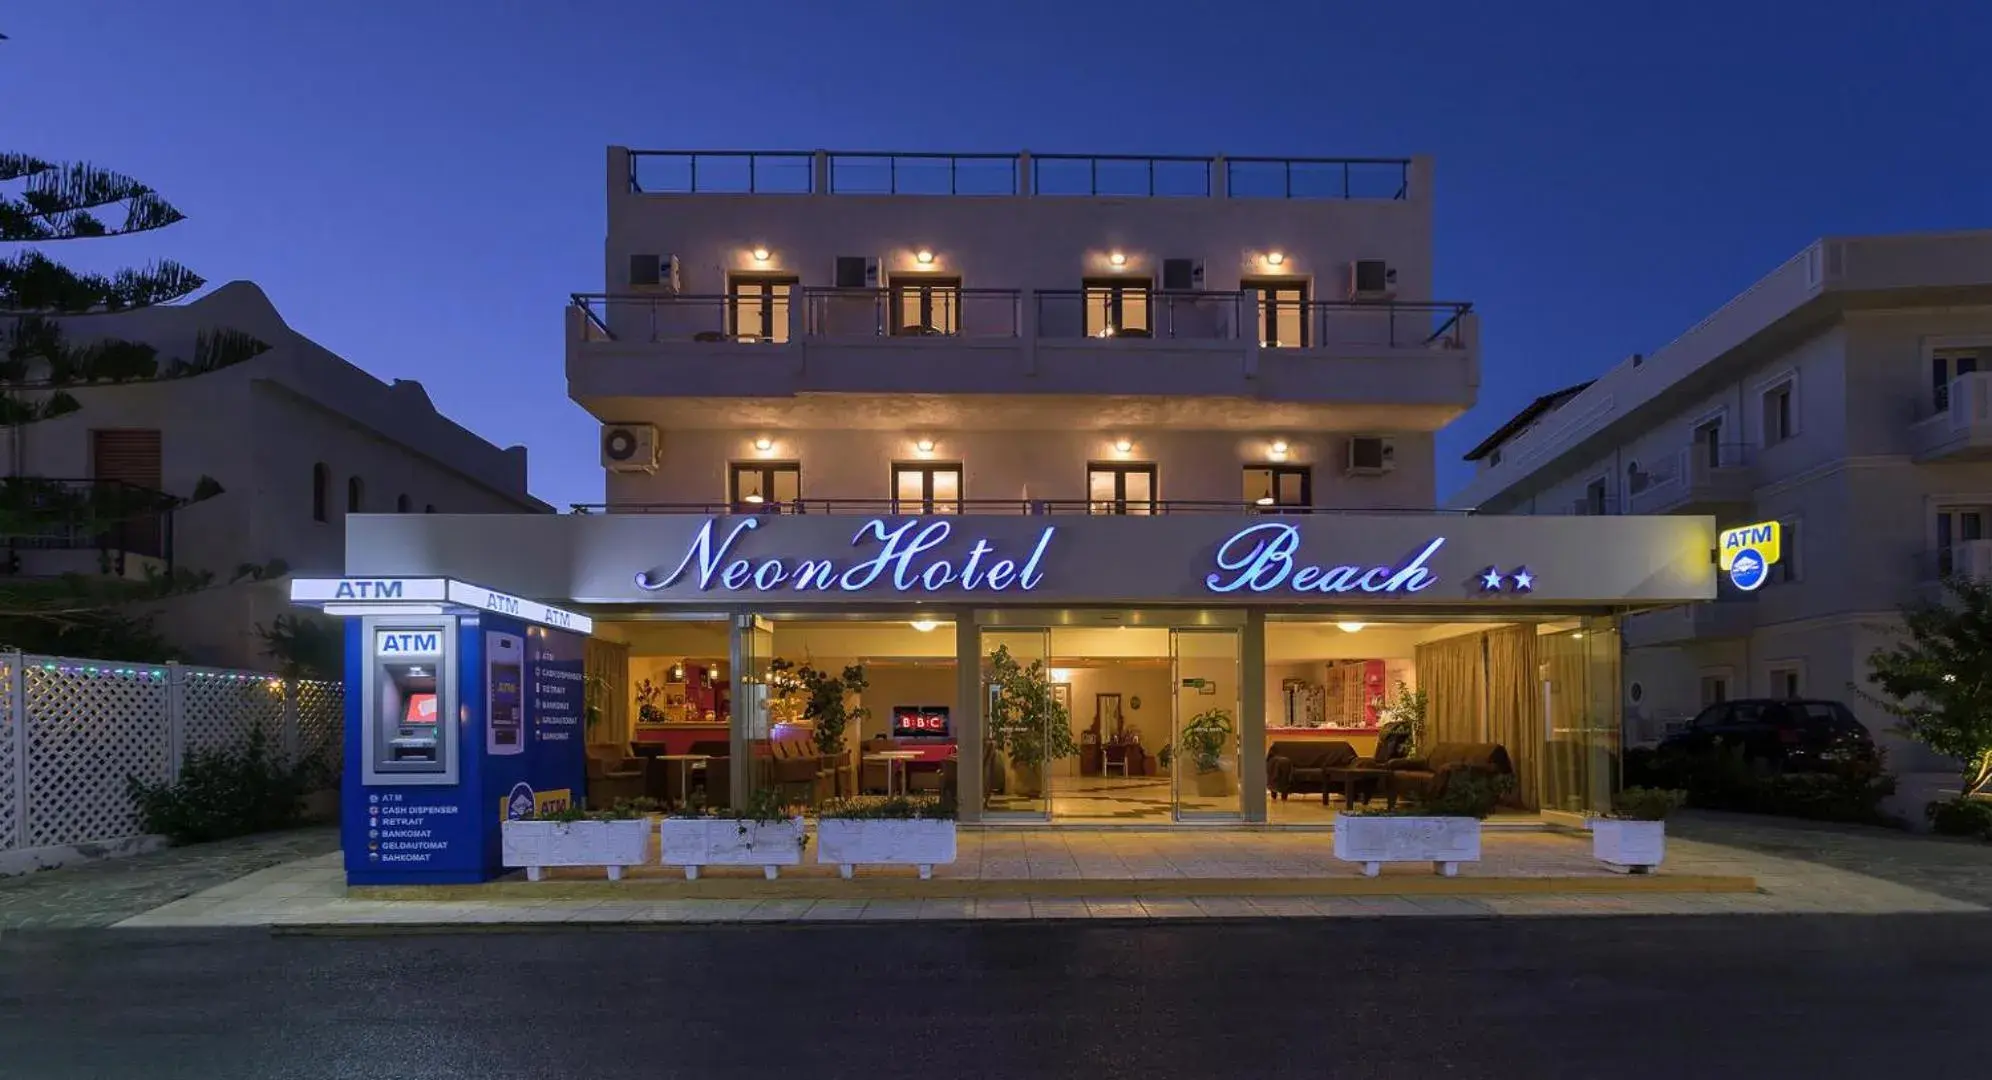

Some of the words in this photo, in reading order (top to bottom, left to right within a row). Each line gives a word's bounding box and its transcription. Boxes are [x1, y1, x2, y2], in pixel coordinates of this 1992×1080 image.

[1726, 525, 1772, 549] ATM
[634, 517, 840, 591] Neon
[841, 518, 1055, 591] Hotel
[1205, 521, 1446, 593] Beach
[335, 581, 402, 598] ATM
[486, 592, 519, 615] ATM
[545, 608, 571, 627] ATM
[382, 634, 437, 652] ATM
[902, 717, 940, 728] BBC
[382, 794, 403, 802] ATM
[382, 806, 407, 814] CASH
[408, 806, 458, 814] DISPENSER
[382, 818, 424, 826] RETRAIT
[382, 830, 432, 838] BANKOMAT
